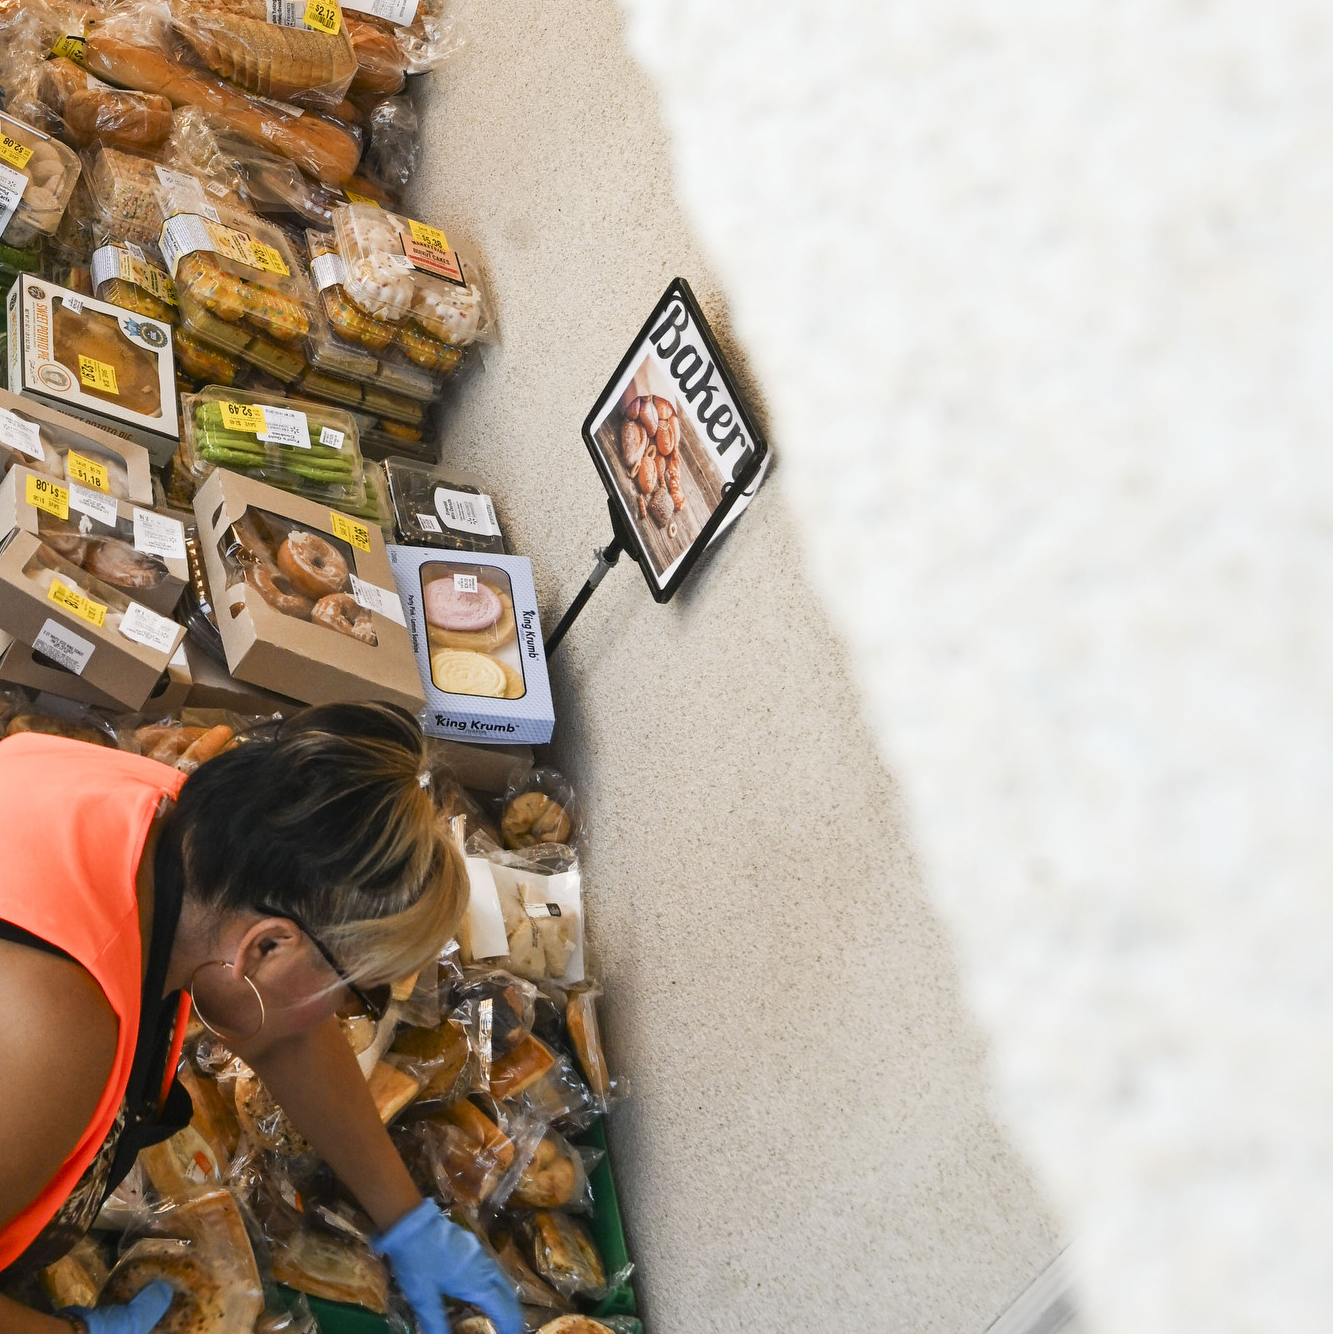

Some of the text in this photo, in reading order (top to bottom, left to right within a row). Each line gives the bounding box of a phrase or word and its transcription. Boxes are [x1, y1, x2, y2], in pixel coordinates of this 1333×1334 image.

[315, 4, 335, 21] $2.12
[3, 137, 24, 153] $2.08
[36, 303, 49, 362] SWEET POTATO PIE
[648, 295, 761, 498] Bakery
[228, 404, 253, 417] $2.49
[78, 469, 101, 487] $1.18
[36, 479, 59, 498] $1.08
[522, 610, 538, 659] King Krumb
[436, 714, 515, 733] King Krumb
